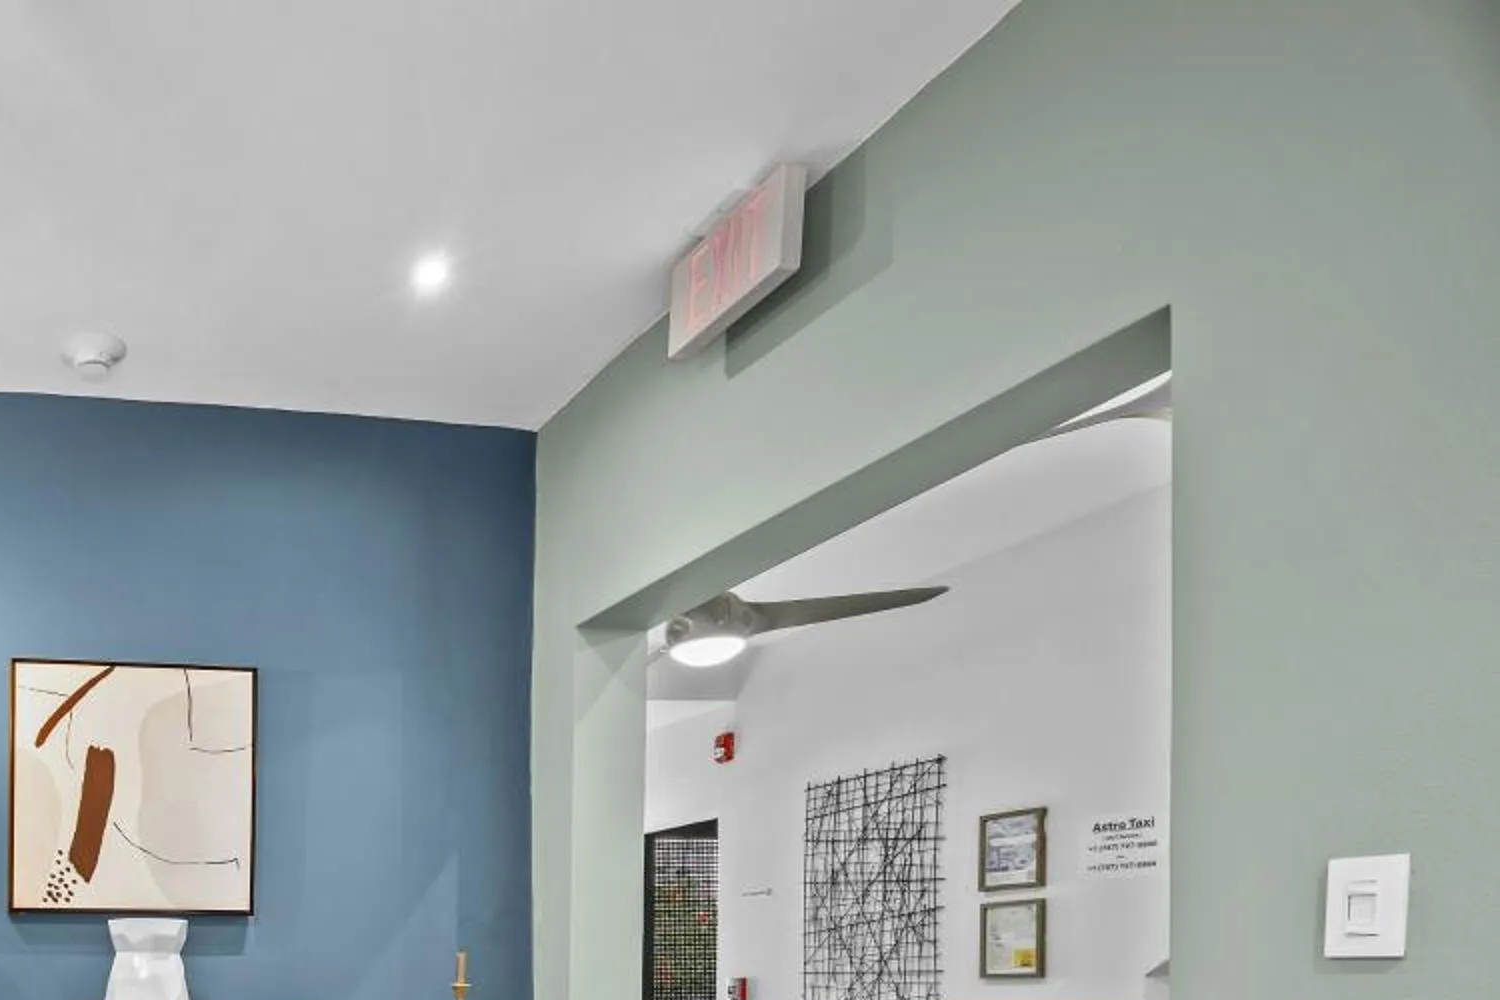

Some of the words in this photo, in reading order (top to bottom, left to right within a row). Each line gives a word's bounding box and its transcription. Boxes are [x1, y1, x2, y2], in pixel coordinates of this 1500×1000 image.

[686, 185, 771, 330] EXIT
[1092, 821, 1127, 832] Astro
[1128, 815, 1155, 829] Taxi
